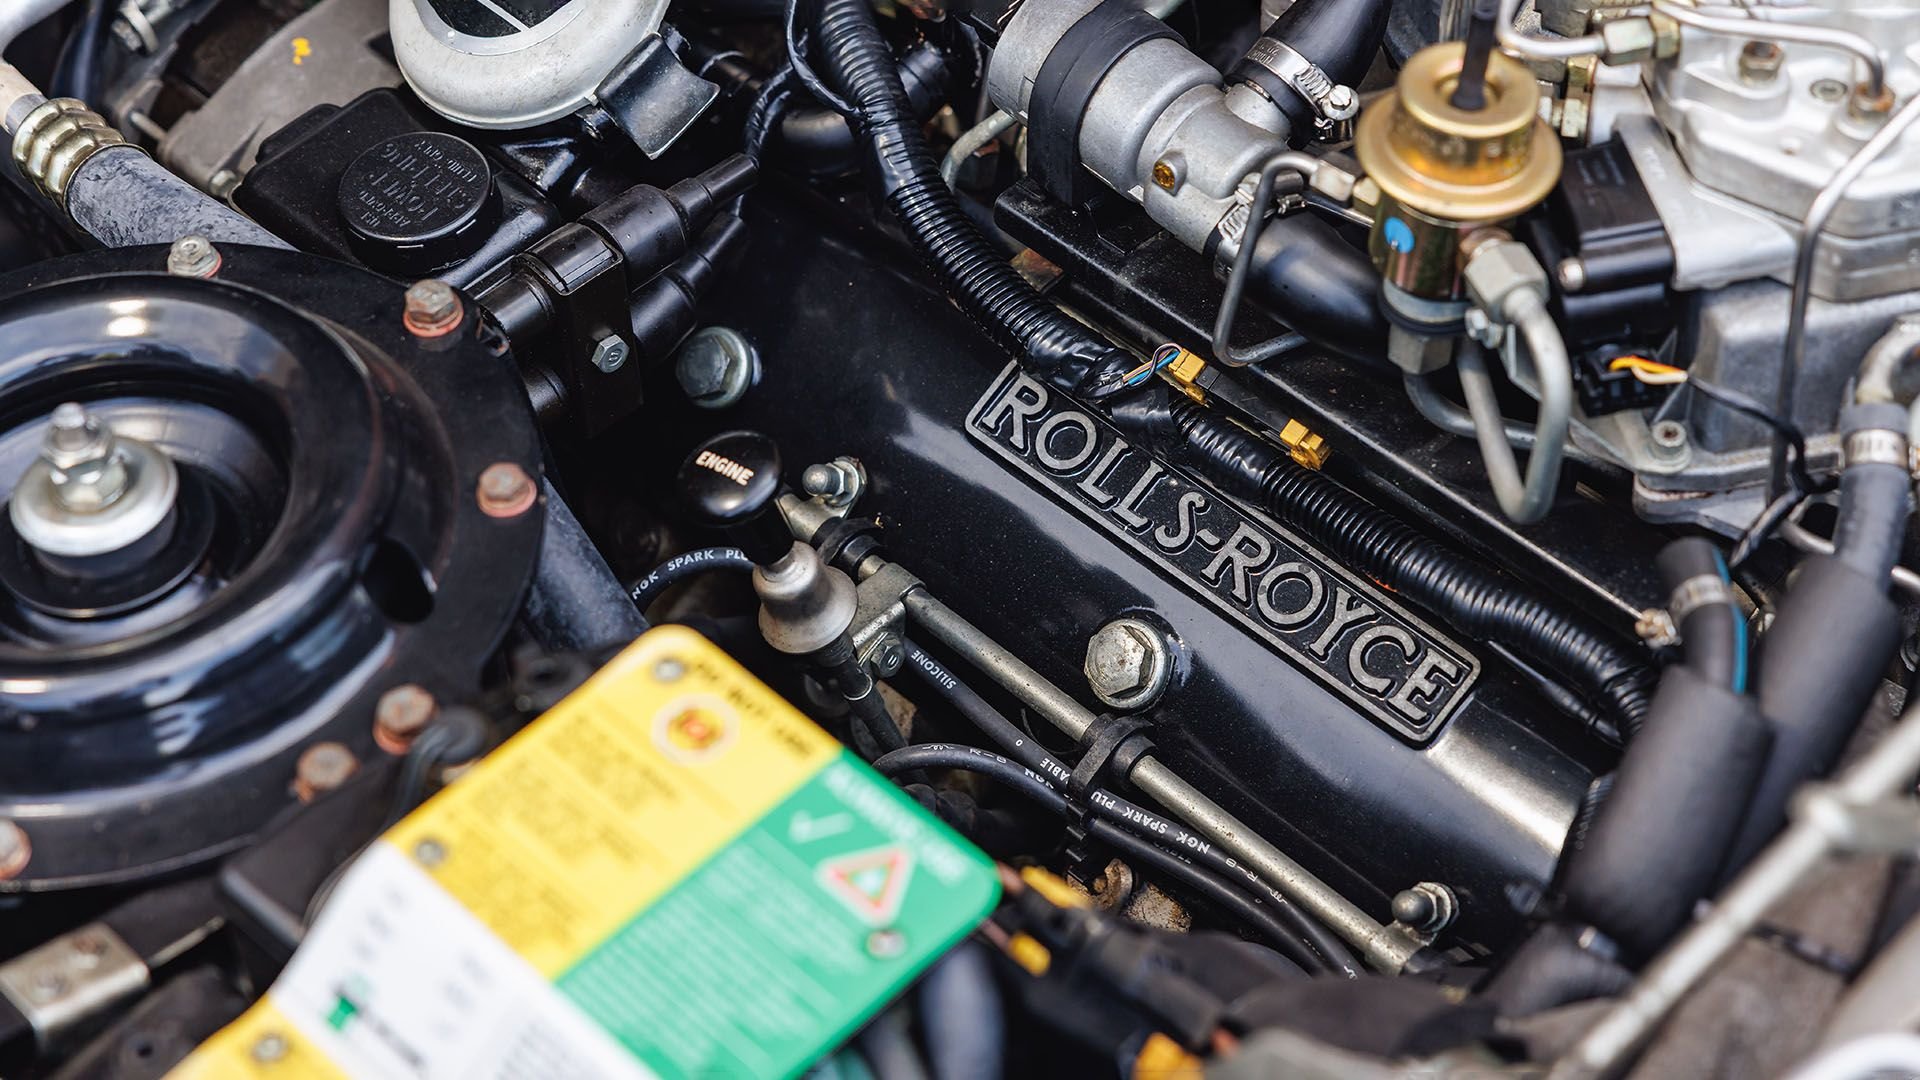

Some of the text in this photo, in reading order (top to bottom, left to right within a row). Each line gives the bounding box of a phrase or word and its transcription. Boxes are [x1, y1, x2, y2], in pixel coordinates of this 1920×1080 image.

[695, 451, 753, 485] ENGINE
[983, 371, 1458, 720] ROLLS-ROYCE
[632, 571, 657, 600] NGK
[667, 550, 714, 570] SPARK
[911, 650, 957, 689] SILICONE
[1040, 758, 1071, 784] ABLE
[1122, 806, 1169, 834] SPARK
[1175, 831, 1210, 854] NGK
